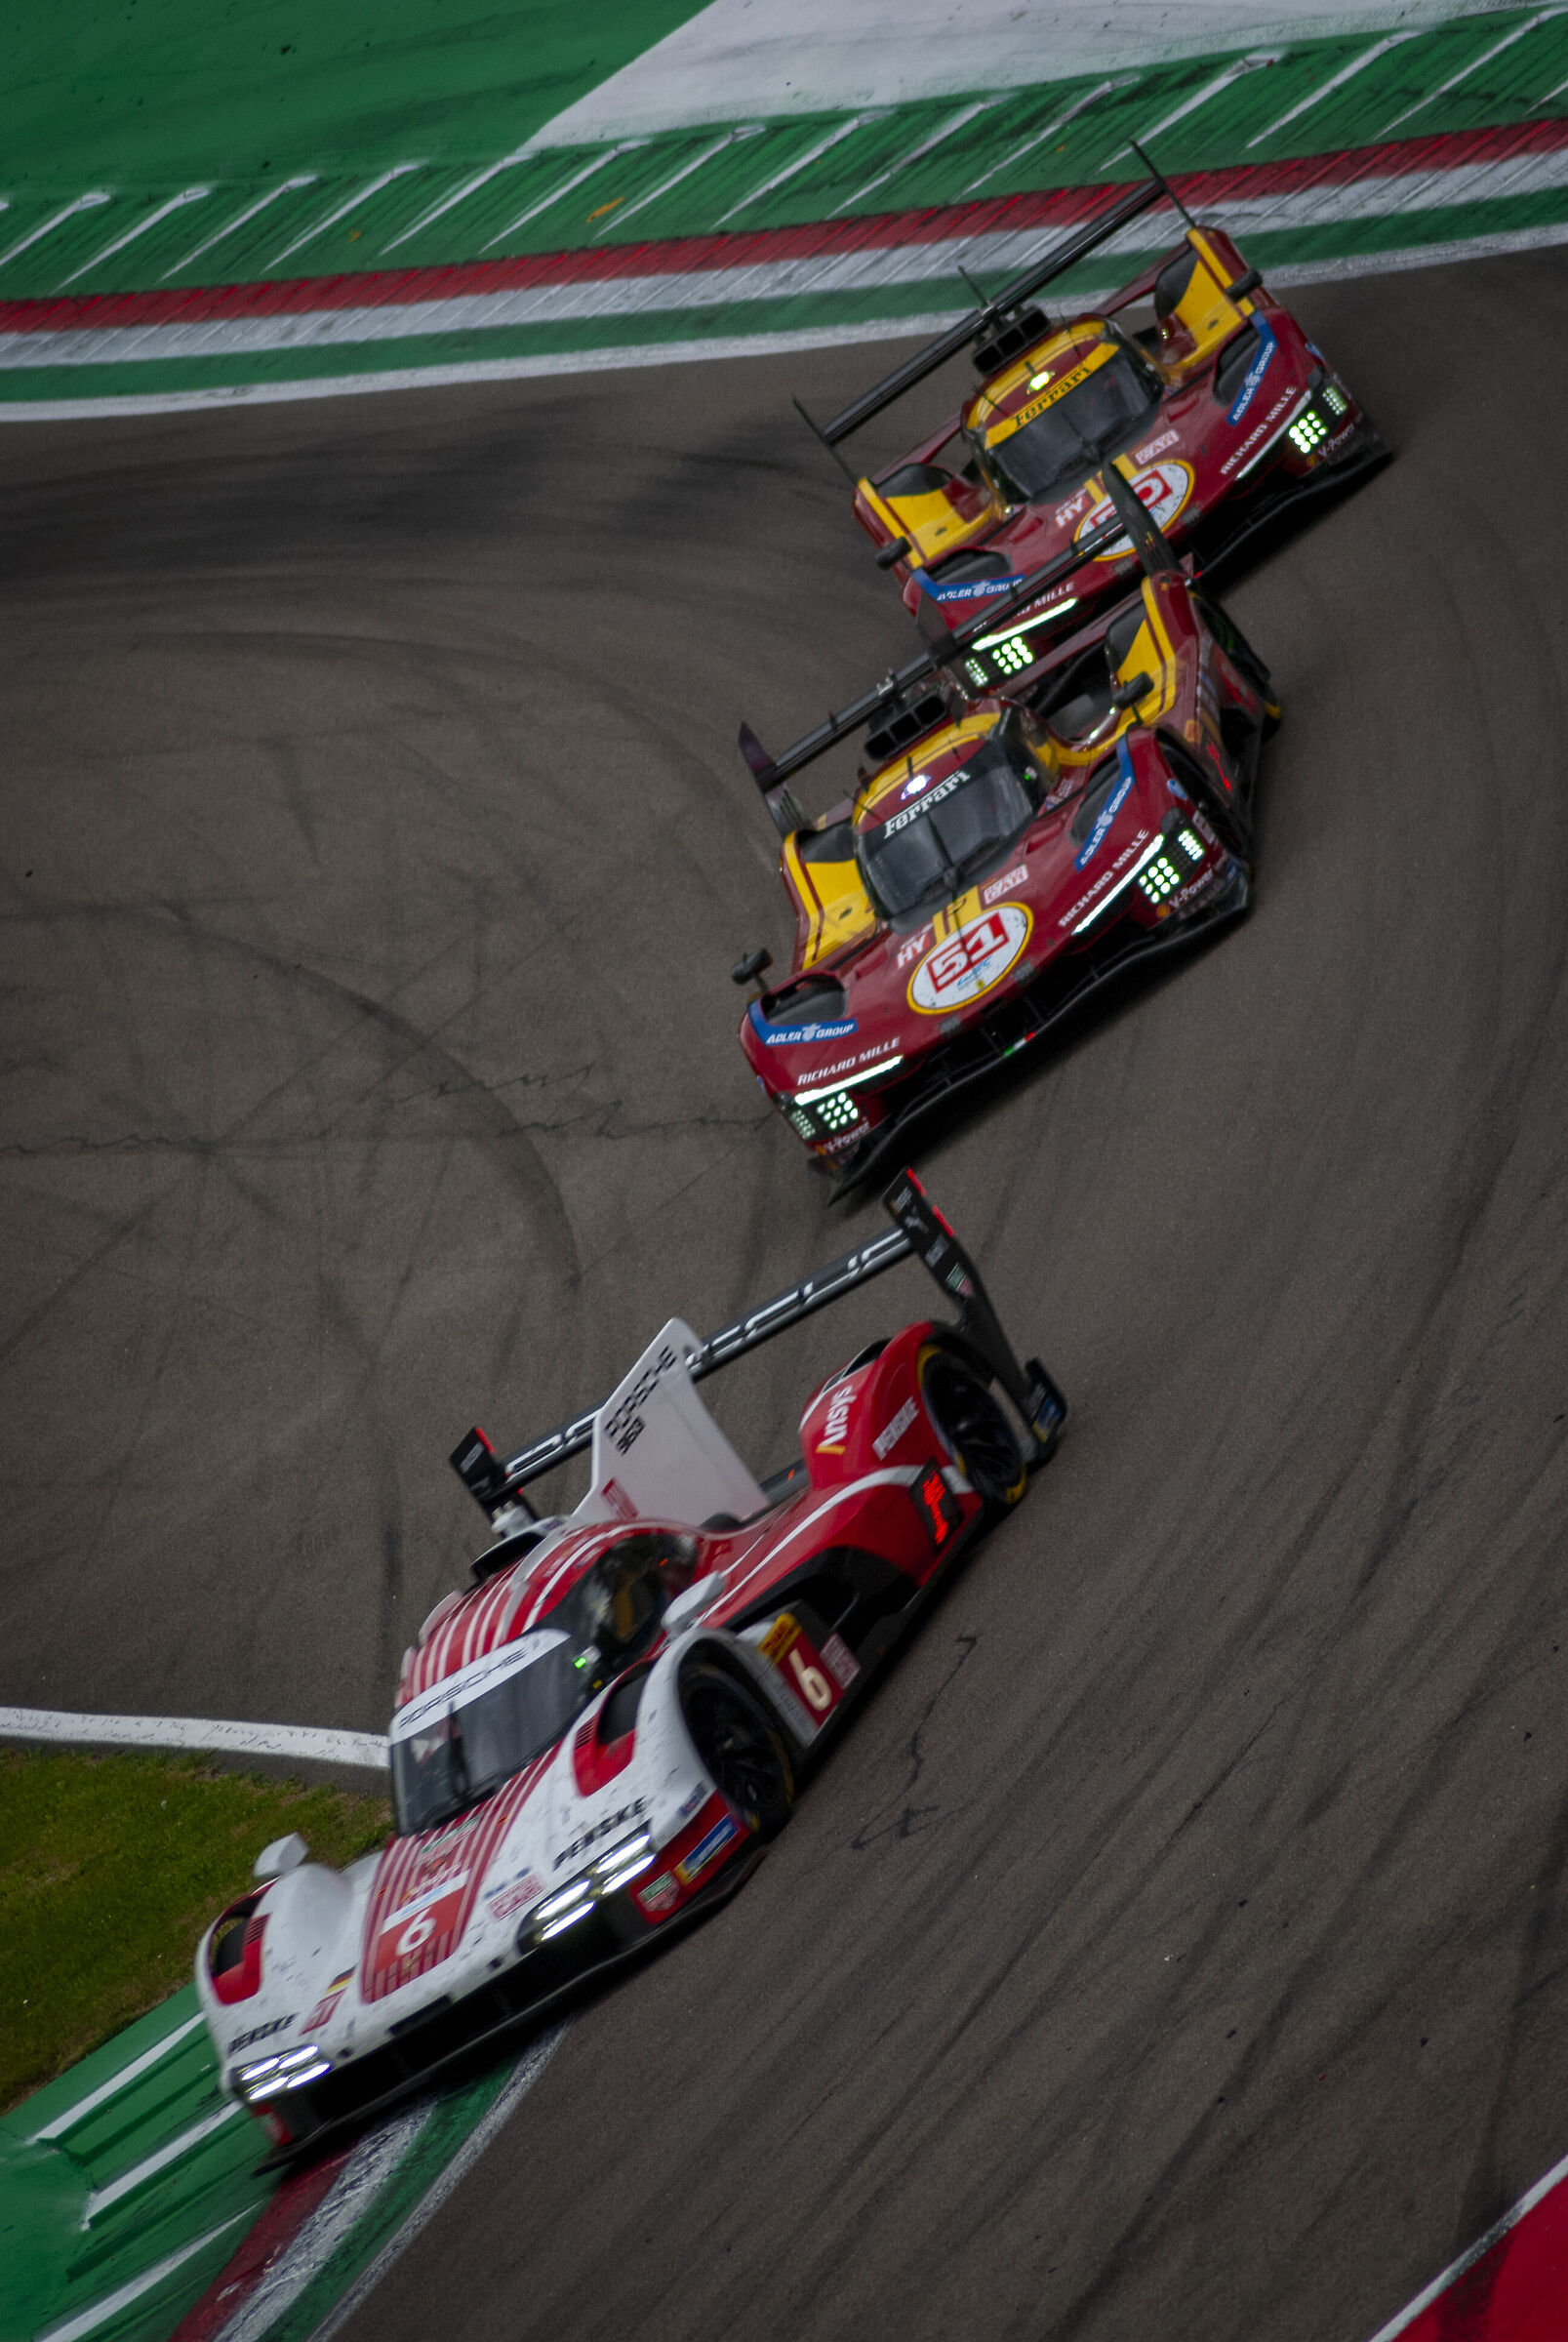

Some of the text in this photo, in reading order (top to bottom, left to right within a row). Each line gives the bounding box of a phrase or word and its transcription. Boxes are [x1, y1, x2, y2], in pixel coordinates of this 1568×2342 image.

[1015, 364, 1091, 427] Ferrari
[1232, 341, 1275, 421] ADLER GROUP
[1220, 385, 1298, 474] RICHARD MILLE
[1033, 582, 1074, 608] MILLE
[883, 769, 971, 839] Ferrari
[1079, 776, 1132, 866] ADLER GROUP
[1058, 828, 1150, 927] RICHARD MILLE
[928, 919, 1007, 988] 51
[765, 1023, 855, 1045] ADLER GROUP
[797, 1036, 901, 1086] RICHARD MILLE
[604, 1344, 677, 1438] PORSCHE
[398, 1646, 528, 1729] PORSCHE
[787, 1646, 833, 1712] 6
[552, 1795, 648, 1873] PENSKE
[394, 1906, 437, 1958] 6
[226, 2012, 299, 2058] PENSKE
